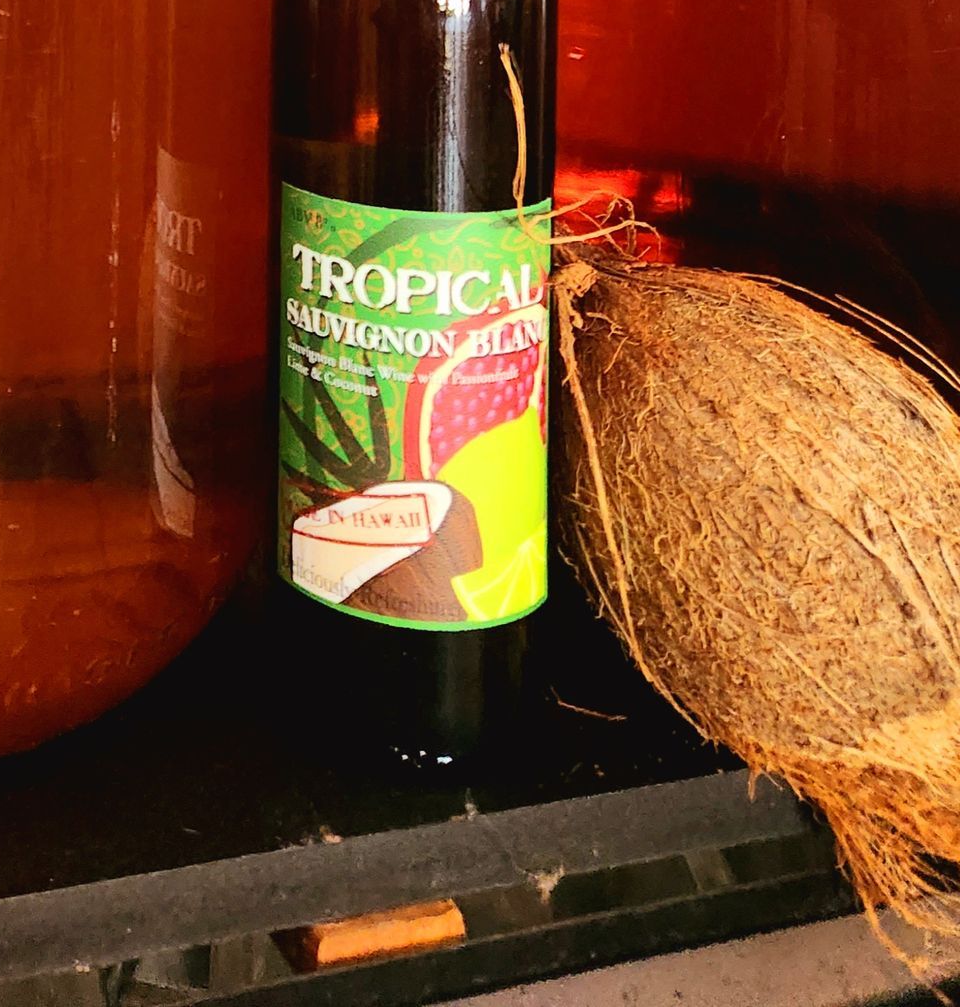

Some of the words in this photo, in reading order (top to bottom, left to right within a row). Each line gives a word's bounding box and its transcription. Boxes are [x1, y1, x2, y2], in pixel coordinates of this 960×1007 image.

[293, 242, 544, 316] TROPICAL
[286, 297, 457, 359] SAUVIGNON
[310, 367, 322, 382] &
[377, 365, 416, 384] Wine
[352, 511, 421, 529] HAWAII
